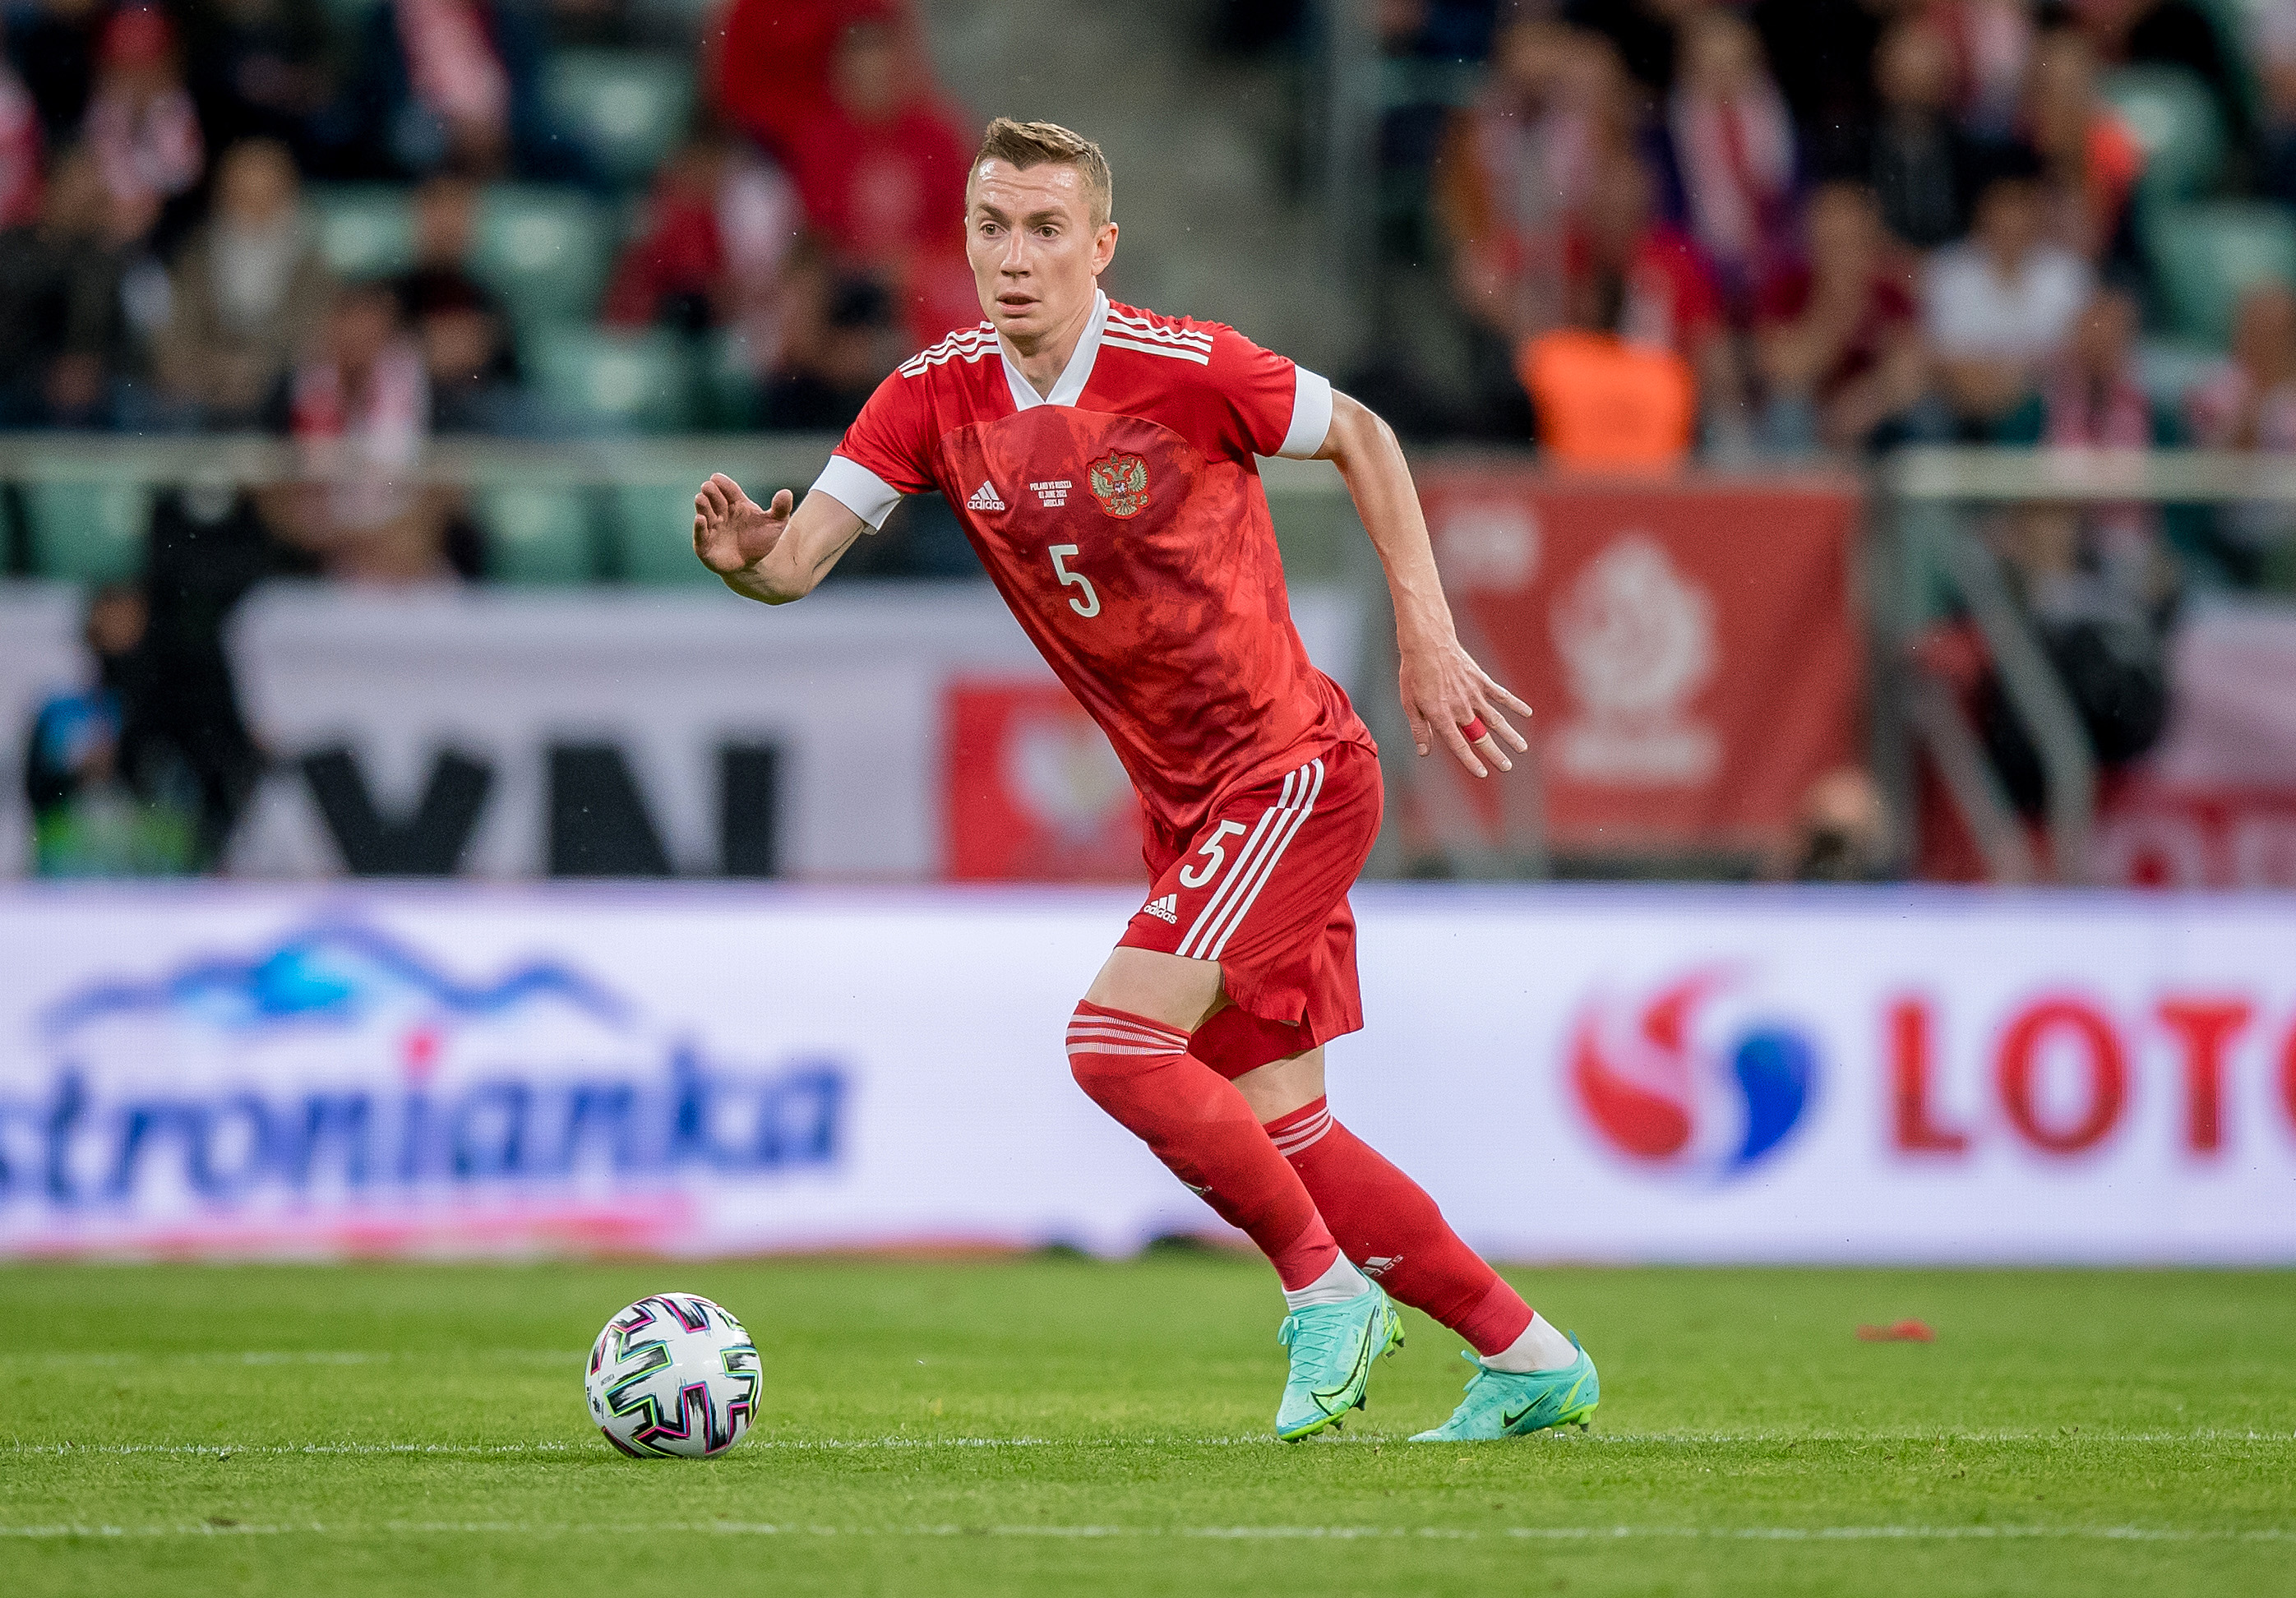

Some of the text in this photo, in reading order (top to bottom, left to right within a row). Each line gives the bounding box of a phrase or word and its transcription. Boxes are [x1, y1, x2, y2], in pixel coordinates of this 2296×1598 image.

[967, 499, 1005, 510] adidas
[1048, 543, 1101, 618] 5
[1179, 819, 1247, 888] 5
[1143, 904, 1178, 925] adidas
[1885, 992, 2296, 1159] LOT
